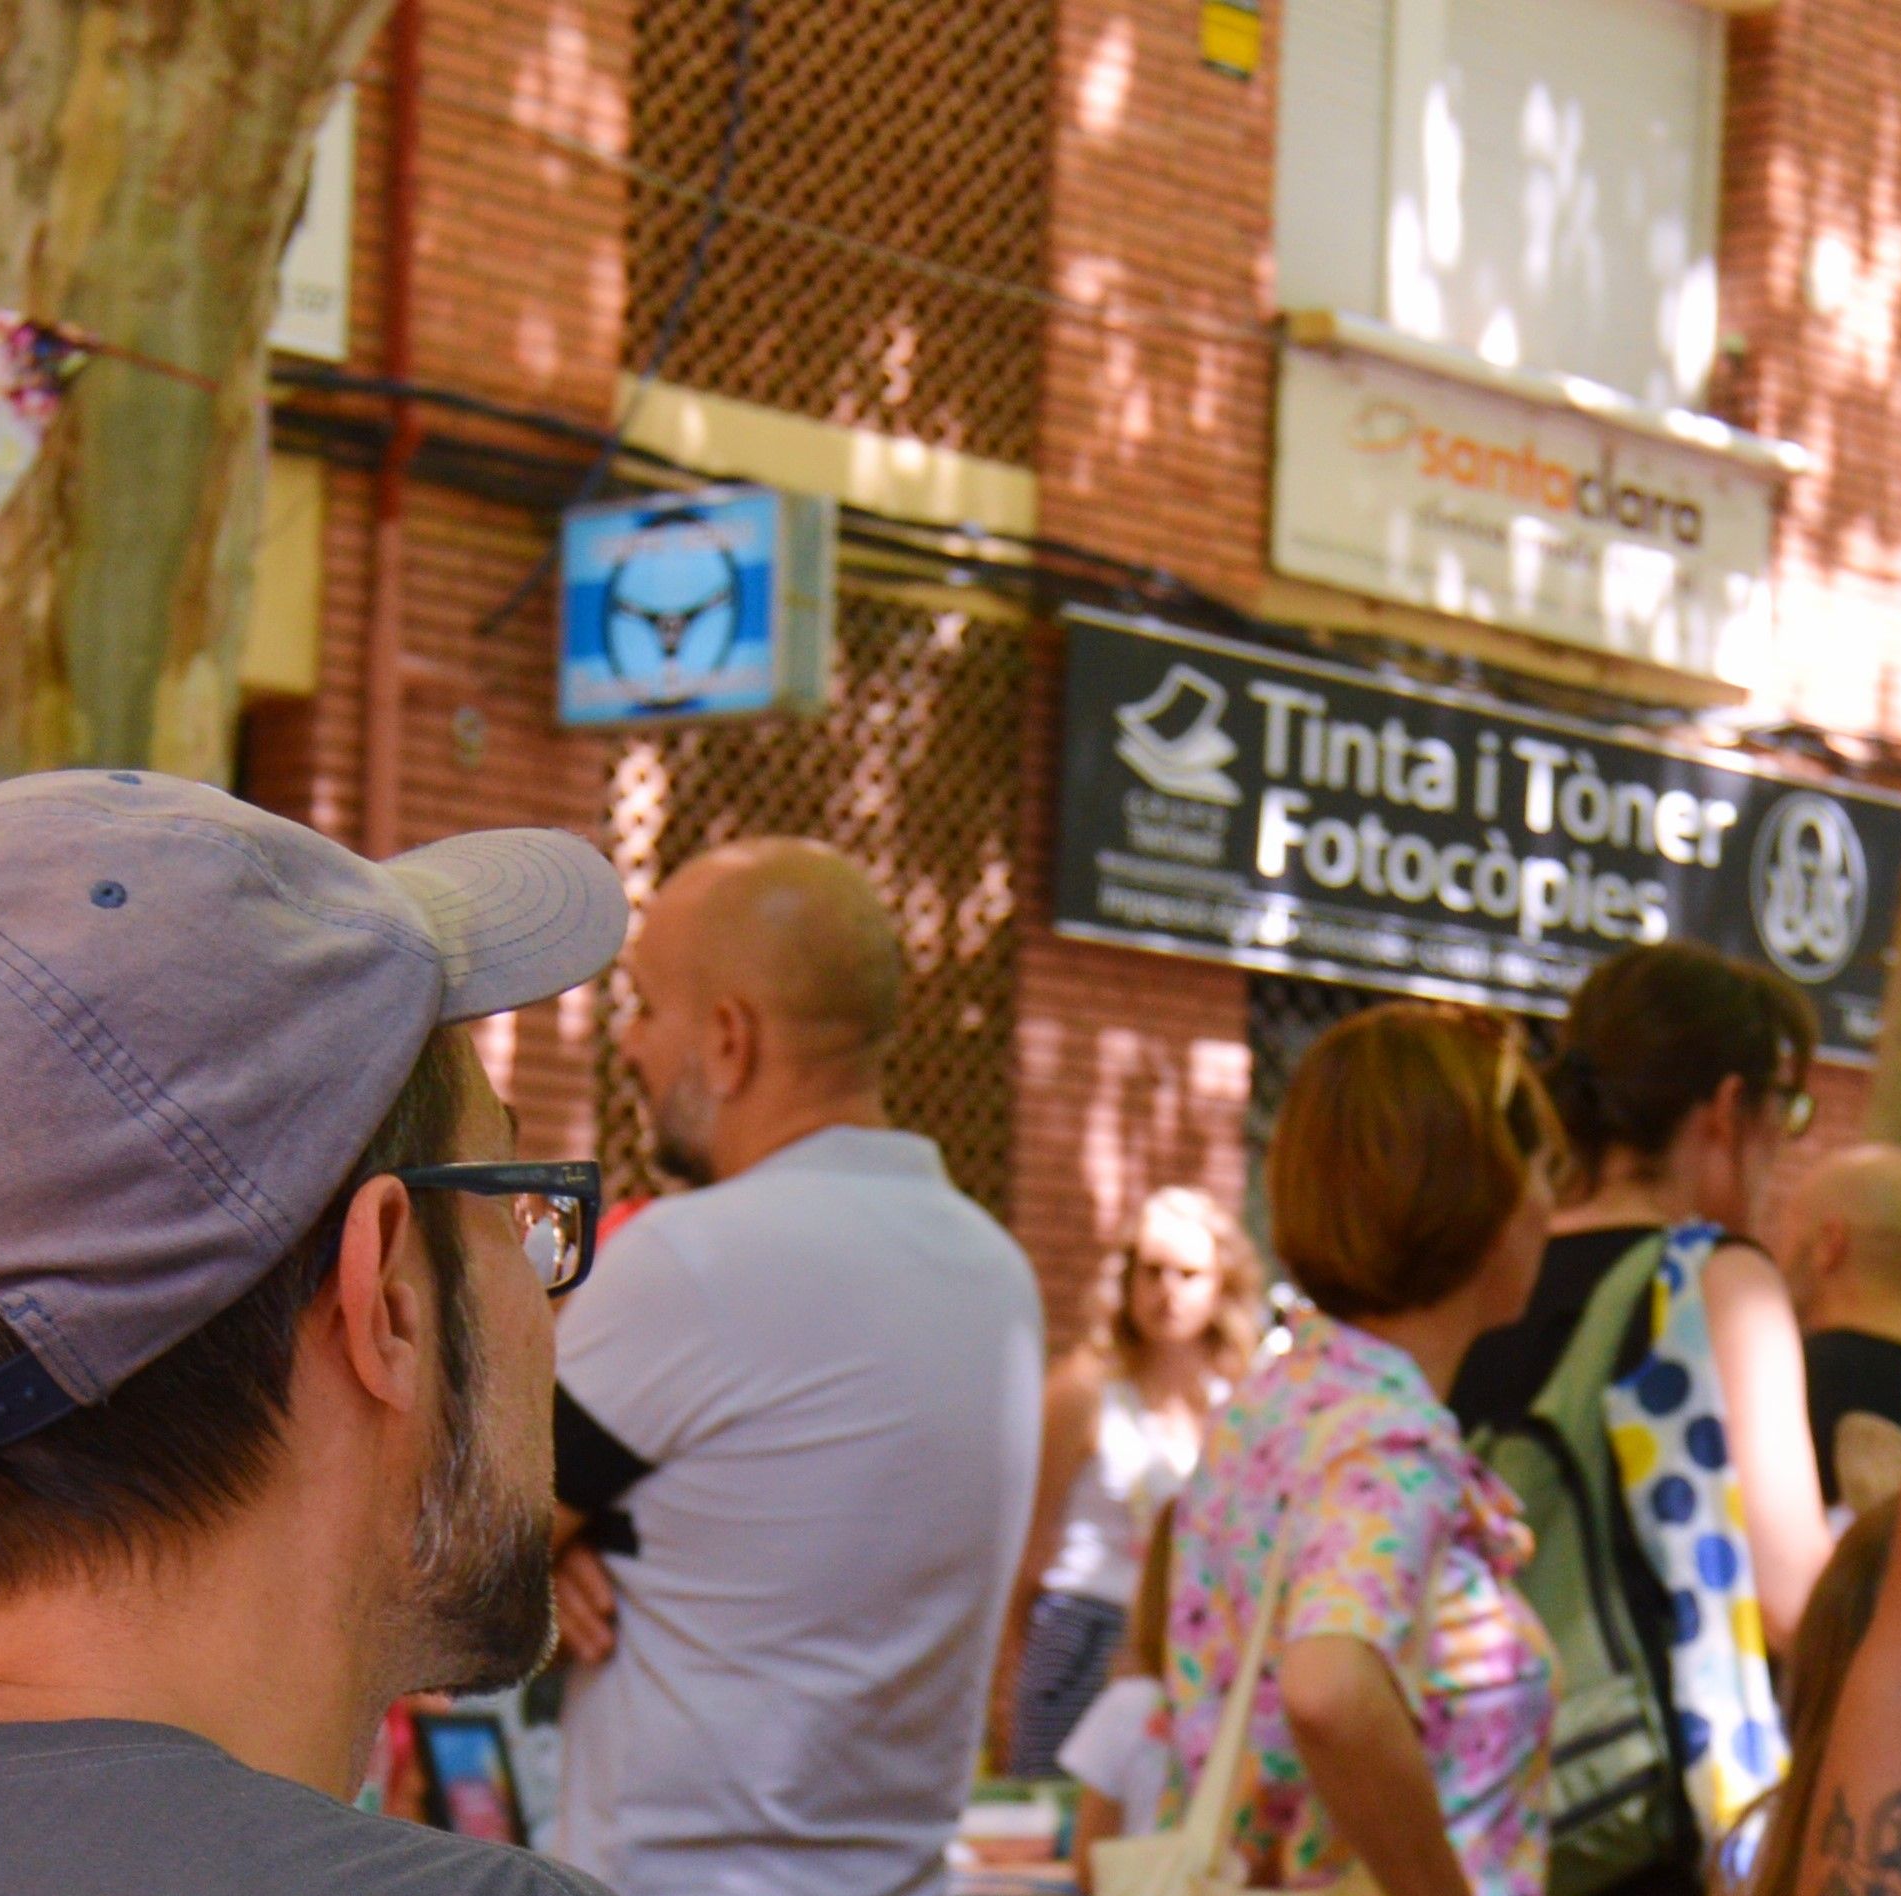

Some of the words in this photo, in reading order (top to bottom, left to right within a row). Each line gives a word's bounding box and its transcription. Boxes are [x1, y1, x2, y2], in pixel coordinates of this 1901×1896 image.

[1419, 424, 1703, 548] santaclara
[1247, 679, 1459, 812] Tinta
[1474, 731, 1501, 822] i
[1511, 736, 1738, 869] Tòner
[1255, 786, 1670, 947] Fotocòpies
